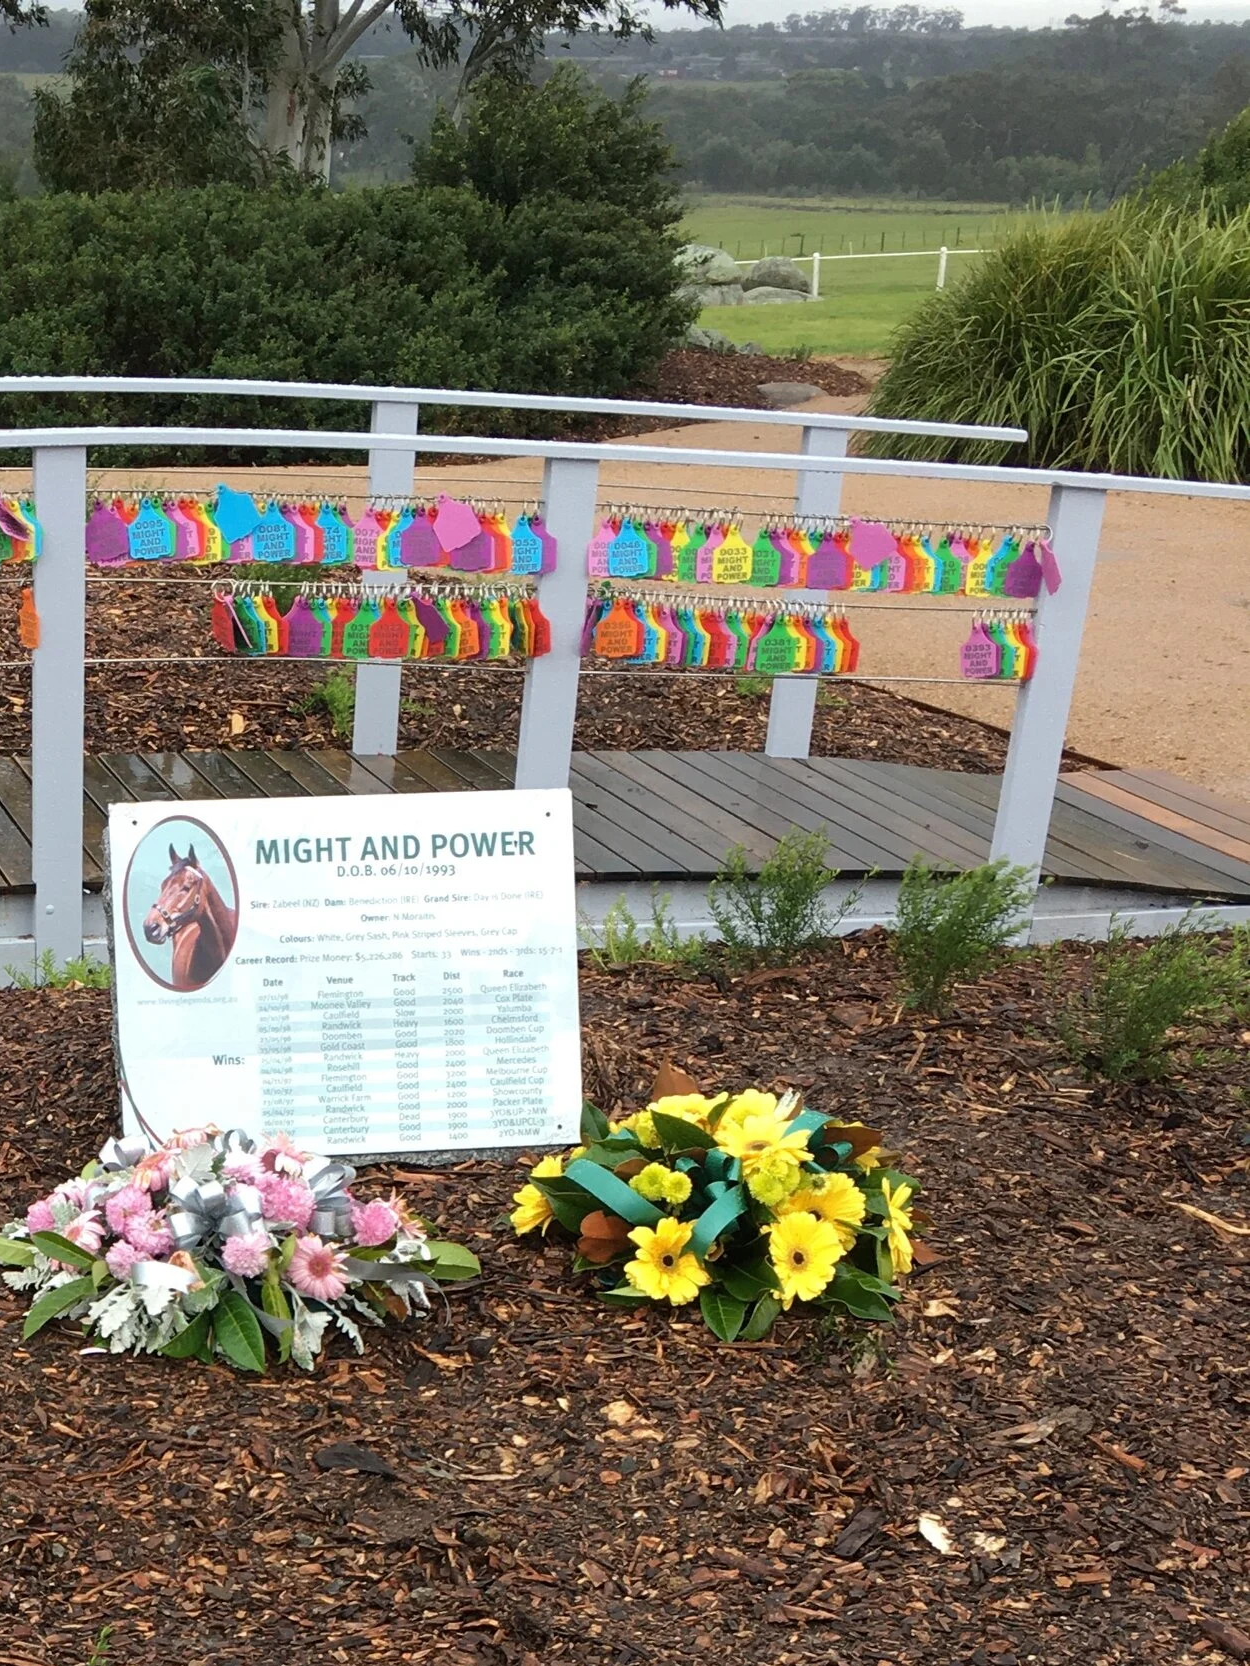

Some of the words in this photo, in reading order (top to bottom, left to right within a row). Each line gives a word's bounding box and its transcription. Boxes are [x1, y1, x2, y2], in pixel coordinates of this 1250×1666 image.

[135, 520, 162, 529] 0095
[258, 524, 286, 532] 0081
[132, 529, 166, 538] MIGHT
[256, 533, 290, 541] MIGHT
[140, 539, 161, 547] AND
[263, 542, 284, 550] AND
[134, 546, 167, 556] POWER
[258, 550, 290, 558] POWER
[718, 556, 748, 564] MIGHT
[717, 572, 747, 580] POWER
[256, 837, 351, 864] MIGHT
[360, 835, 420, 861] AND
[431, 831, 536, 858] POWER
[337, 864, 376, 877] D.O.B.
[380, 863, 456, 877] 06/10/1993
[250, 901, 270, 909] Sire:
[272, 899, 300, 908] Zabeel
[303, 899, 320, 909] (NZ)
[324, 899, 346, 907] Dam:
[349, 896, 397, 905] Benediction
[424, 894, 449, 903] Grand
[452, 894, 471, 902] Sire:
[474, 893, 489, 902] Day
[501, 892, 522, 900] Done
[361, 914, 390, 922] Owner:
[393, 913, 400, 921] N
[280, 935, 315, 944] Colours:
[317, 934, 344, 942] White,
[346, 933, 364, 942] Grey
[366, 932, 390, 941] Sash,
[392, 931, 409, 939] Pink
[412, 930, 442, 940] Striped
[444, 928, 478, 938] Sleeves,
[481, 928, 499, 937] Grey
[502, 927, 518, 936] Cap
[235, 957, 263, 965] Career
[266, 955, 298, 964] Record:
[300, 954, 320, 963] Prize
[322, 954, 352, 964] Money:
[411, 950, 438, 959] Starts:
[442, 951, 452, 960] 33
[460, 948, 481, 957] Wins
[488, 947, 508, 956] 2nds
[515, 946, 536, 956] 3rds:
[263, 978, 284, 987] Date
[326, 976, 354, 985] Venue
[392, 974, 416, 982] Track
[443, 972, 461, 980] Dist
[503, 970, 524, 978] Race
[318, 990, 364, 999] Flemington
[394, 988, 416, 996] Good
[442, 987, 463, 996] 2500
[480, 984, 507, 993] Queen
[510, 983, 546, 992] Elizabeth
[310, 1001, 344, 1010] Moonee
[346, 1000, 371, 1009] Valley
[394, 998, 416, 1006] Good
[442, 998, 464, 1006] 2040
[495, 994, 510, 1002] Cox
[512, 994, 533, 1002] Plate
[323, 1011, 360, 1020] Caulfield
[396, 1009, 416, 1017] Slow
[497, 1004, 532, 1012] Yalumba
[322, 1021, 362, 1030] Randwick
[393, 1019, 418, 1028] Heavy
[444, 1018, 464, 1026] 1600
[492, 1014, 538, 1024] Chelmsford
[322, 1032, 362, 1040] Doomben
[395, 1030, 417, 1038] Good
[486, 1025, 526, 1034] Doomben
[528, 1024, 544, 1033] Cup
[320, 1042, 340, 1052] Gold
[342, 1042, 365, 1050] Coast
[396, 1040, 418, 1048] Good
[445, 1038, 464, 1046] 1800
[495, 1036, 536, 1044] Hollindale
[212, 1054, 245, 1066] Wins:
[324, 1052, 362, 1062] Randwick
[395, 1050, 419, 1060] Heavy
[483, 1047, 509, 1056] Queen
[512, 1045, 549, 1054] Elizabeth
[326, 1062, 360, 1072] Rosehill
[446, 1060, 466, 1068] 2400
[496, 1056, 536, 1065] Mercedes
[321, 1073, 366, 1084] Flemington
[397, 1071, 418, 1079] Good
[446, 1070, 466, 1079] 3200
[486, 1067, 529, 1076] Melbourne
[532, 1066, 548, 1075] Cup
[326, 1084, 362, 1092] Caulfield
[397, 1082, 419, 1090] Good
[490, 1077, 526, 1086] Caulfield
[528, 1076, 544, 1085] Cup
[352, 1094, 371, 1102] Farm
[398, 1092, 420, 1100] Good
[326, 1104, 365, 1114] Randwick
[398, 1102, 420, 1110] Good
[493, 1098, 520, 1106] Packer
[522, 1098, 543, 1106] Plate
[323, 1115, 368, 1124] Canterbury
[399, 1112, 420, 1120] Dead
[448, 1112, 467, 1120] 1900
[323, 1125, 369, 1134] Canterbury
[399, 1123, 421, 1131] Good
[448, 1122, 468, 1130] 1900
[327, 1135, 366, 1144] Randwick
[400, 1133, 422, 1142] Good
[449, 1132, 468, 1140] 1400
